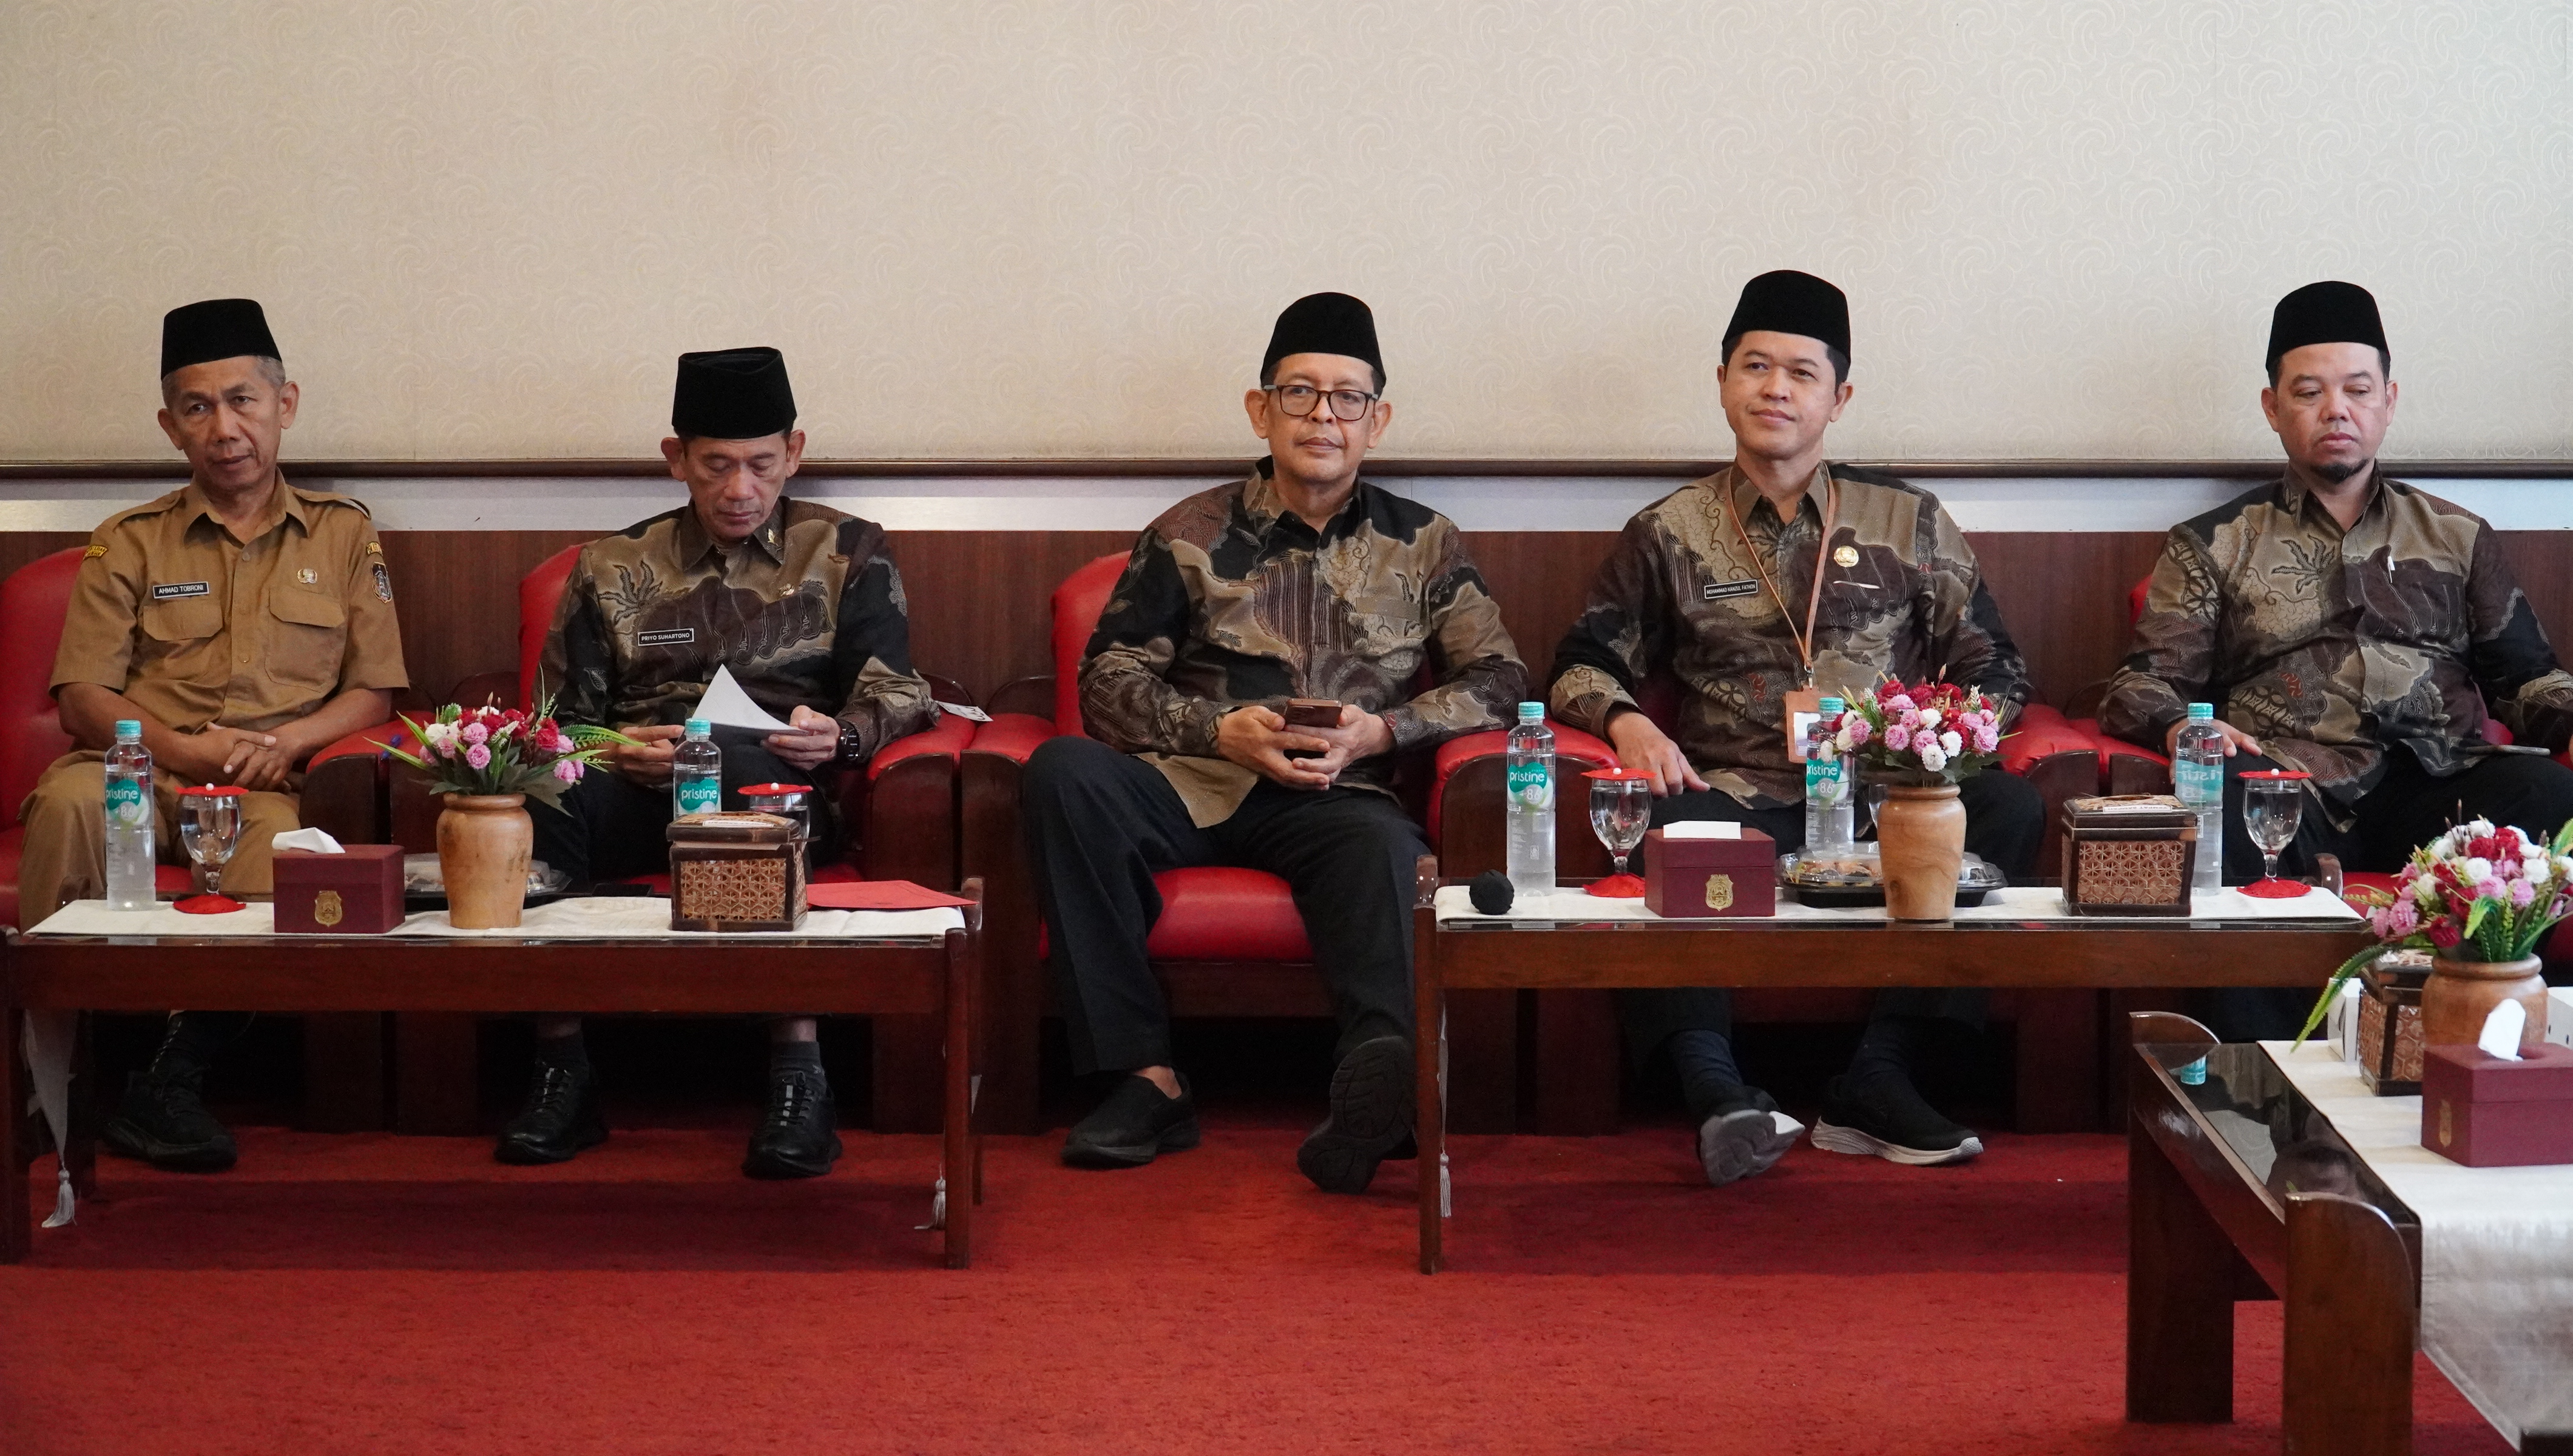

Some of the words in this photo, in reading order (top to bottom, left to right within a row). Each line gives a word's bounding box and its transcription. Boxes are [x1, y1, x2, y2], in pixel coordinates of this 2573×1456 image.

[1509, 771, 1545, 783] pristine
[106, 788, 138, 801] pristine
[681, 789, 717, 801] pristine
